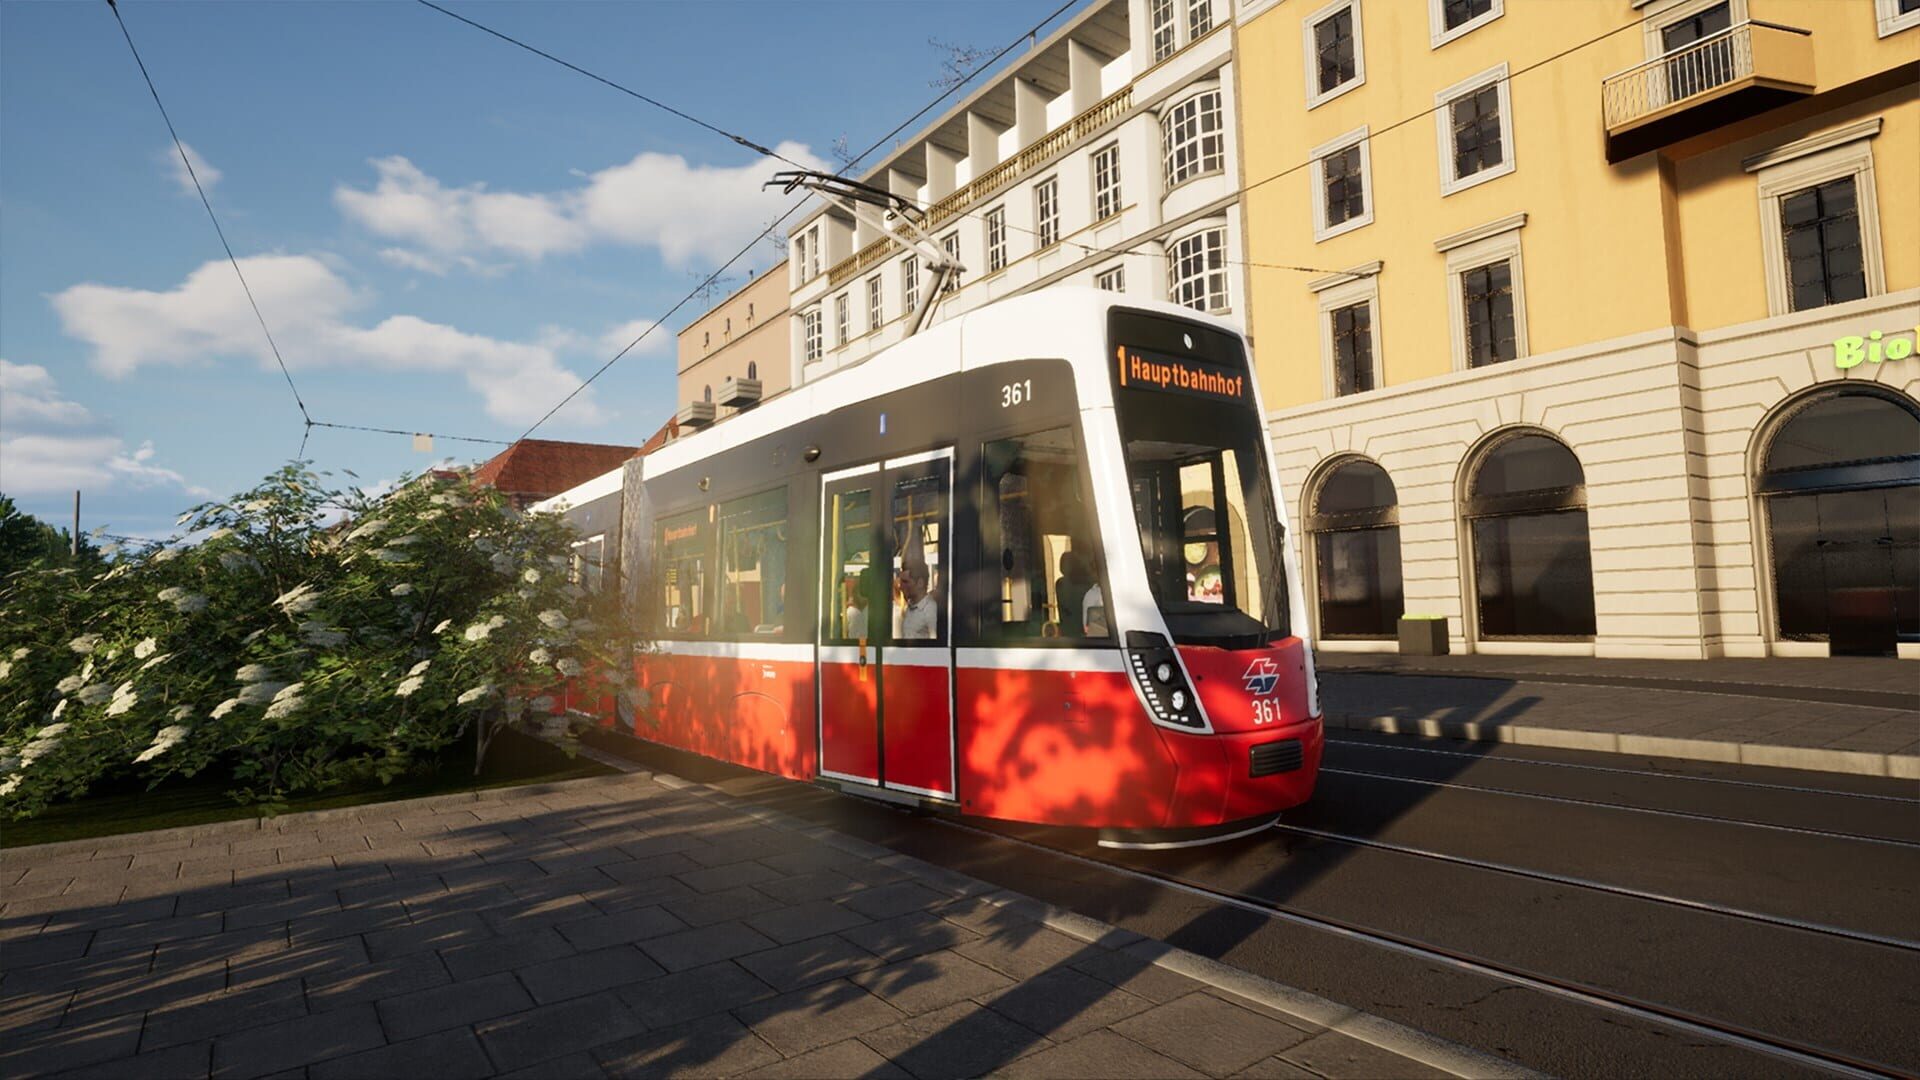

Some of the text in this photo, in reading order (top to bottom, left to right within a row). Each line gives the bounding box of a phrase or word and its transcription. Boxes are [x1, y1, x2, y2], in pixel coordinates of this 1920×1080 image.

[1833, 325, 1920, 369] Bio
[1117, 345, 1243, 397] 1 Hauptbahnhof
[1001, 379, 1032, 408] 361
[1252, 697, 1282, 725] 361
